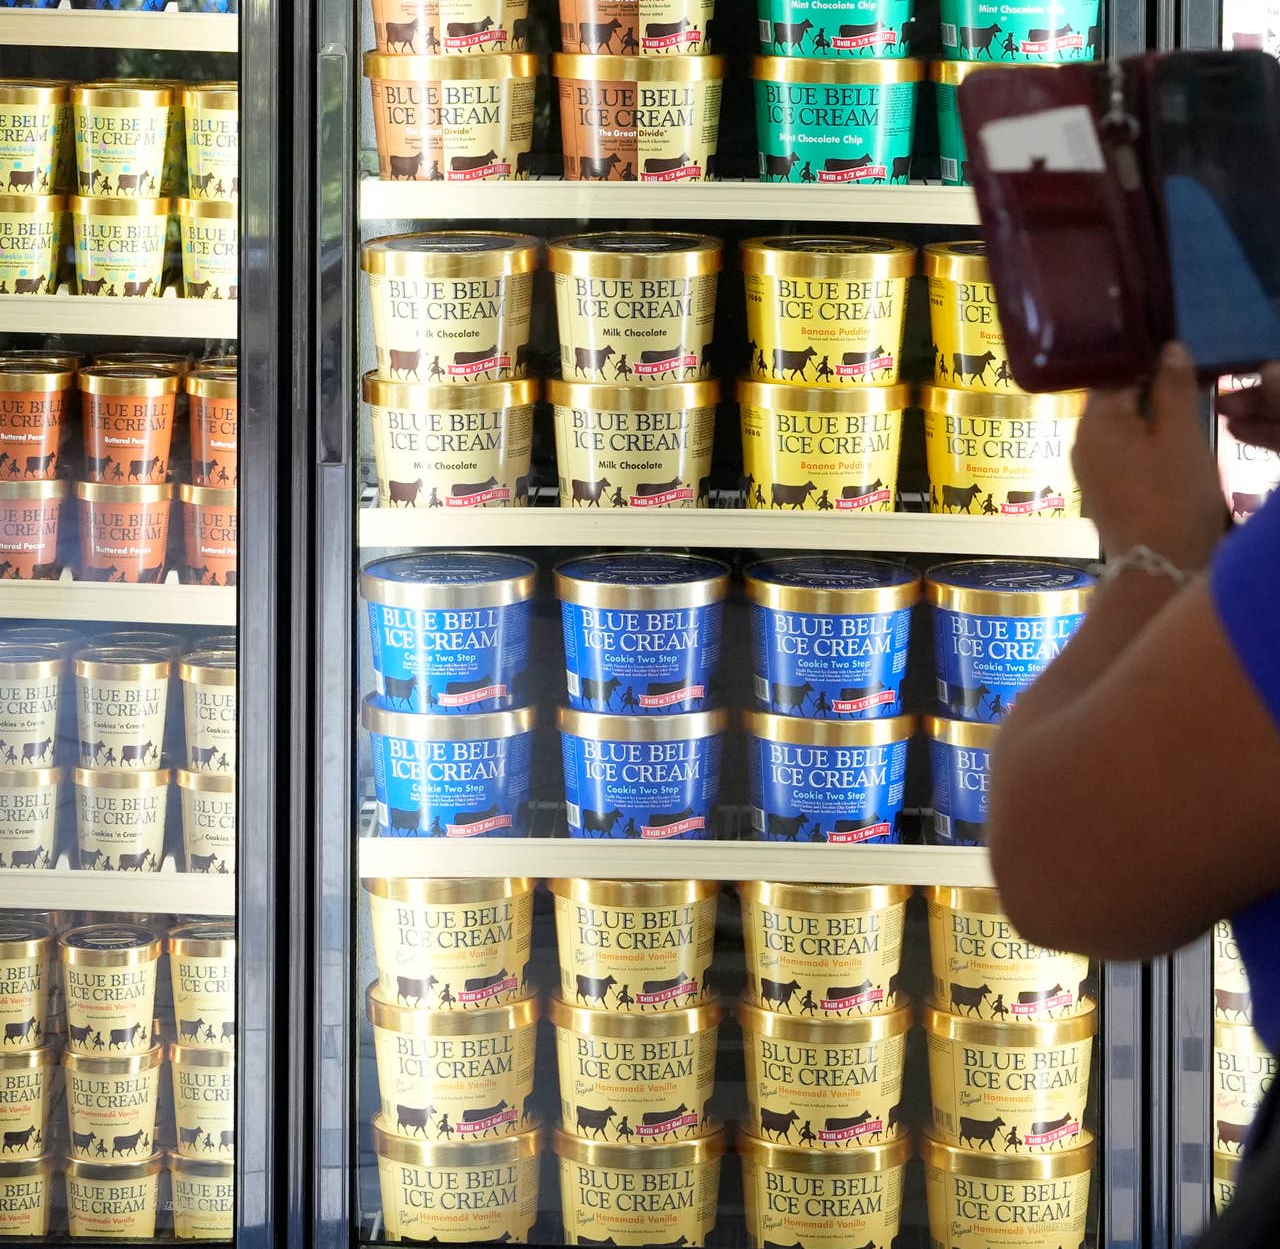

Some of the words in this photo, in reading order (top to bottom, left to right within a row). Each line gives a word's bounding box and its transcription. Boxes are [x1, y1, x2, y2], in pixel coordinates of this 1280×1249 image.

[791, 1, 808, 9] Mint
[812, 1, 854, 9] Chocolate
[858, 1, 876, 10] Chip
[603, 328, 621, 337] Milk
[624, 328, 667, 338] Chocolate
[801, 327, 835, 336] Banana
[648, 952, 677, 960] Vanilla
